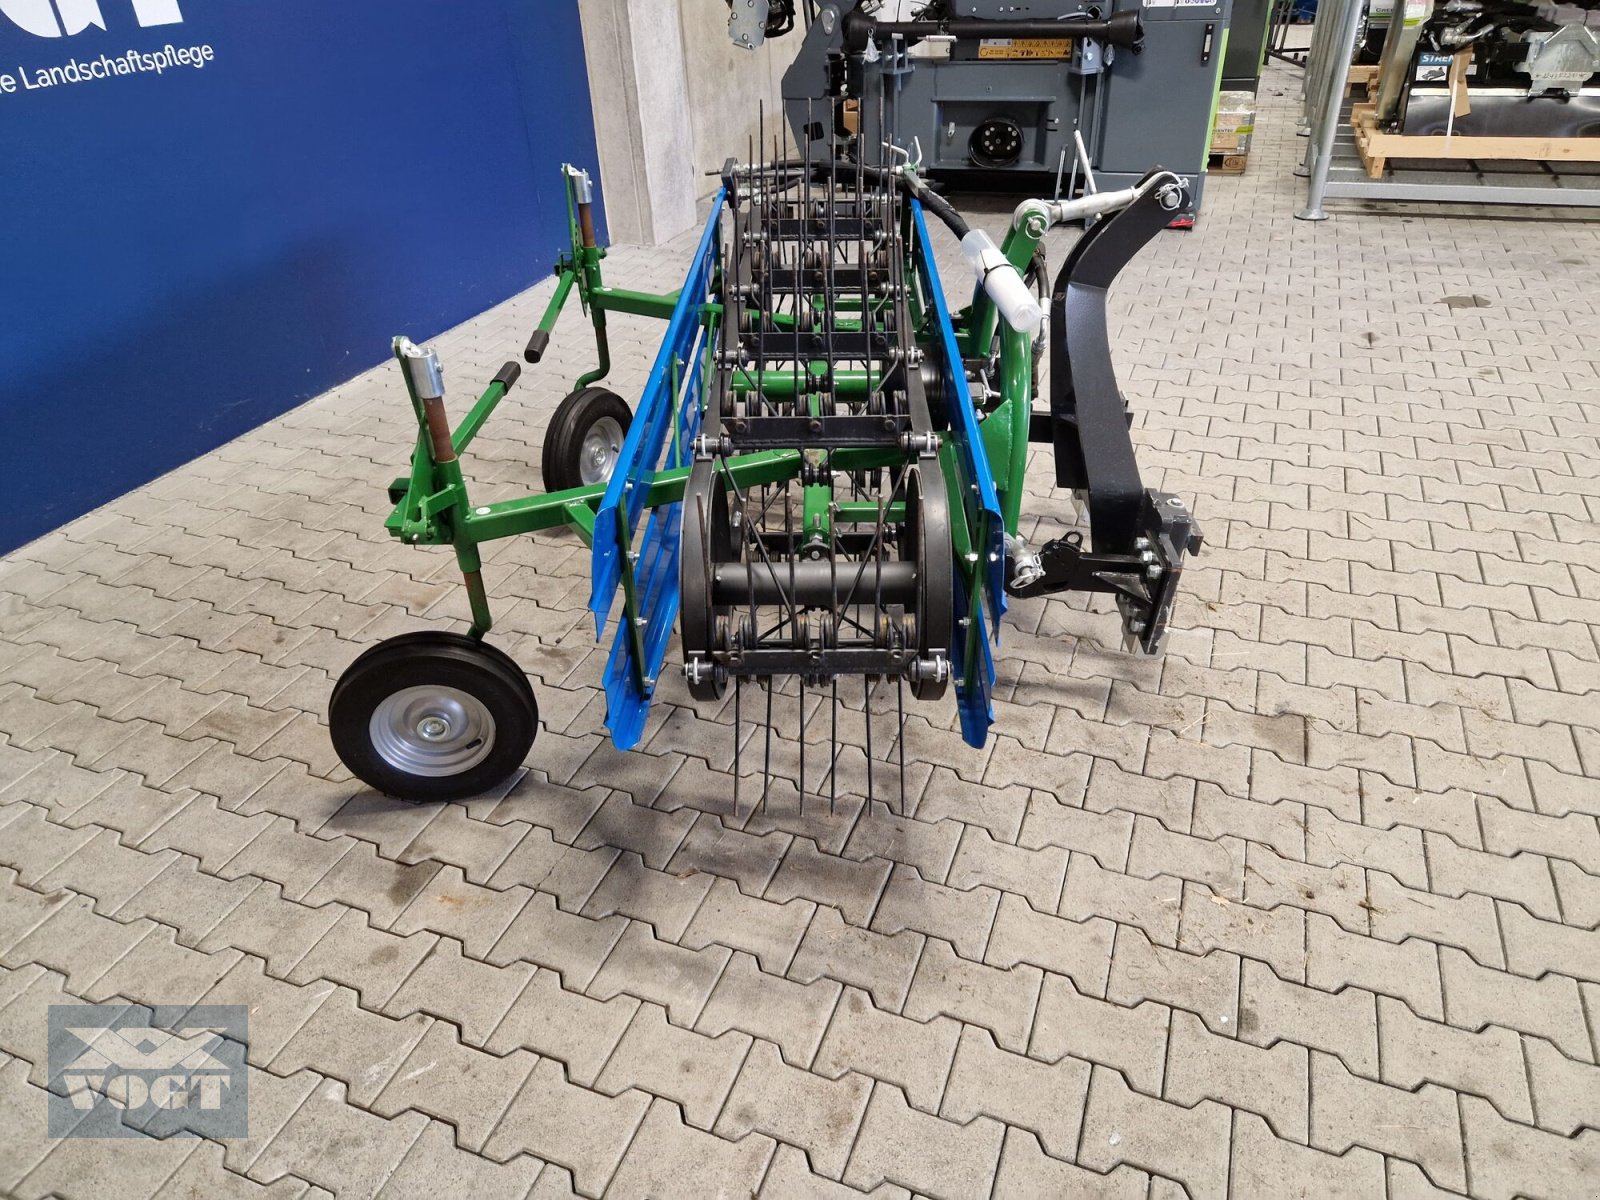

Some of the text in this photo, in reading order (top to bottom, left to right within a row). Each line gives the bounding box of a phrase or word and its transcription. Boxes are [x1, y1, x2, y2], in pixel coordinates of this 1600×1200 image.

[0, 44, 215, 94] e Landschaftspflege
[1421, 54, 1454, 63] STREN
